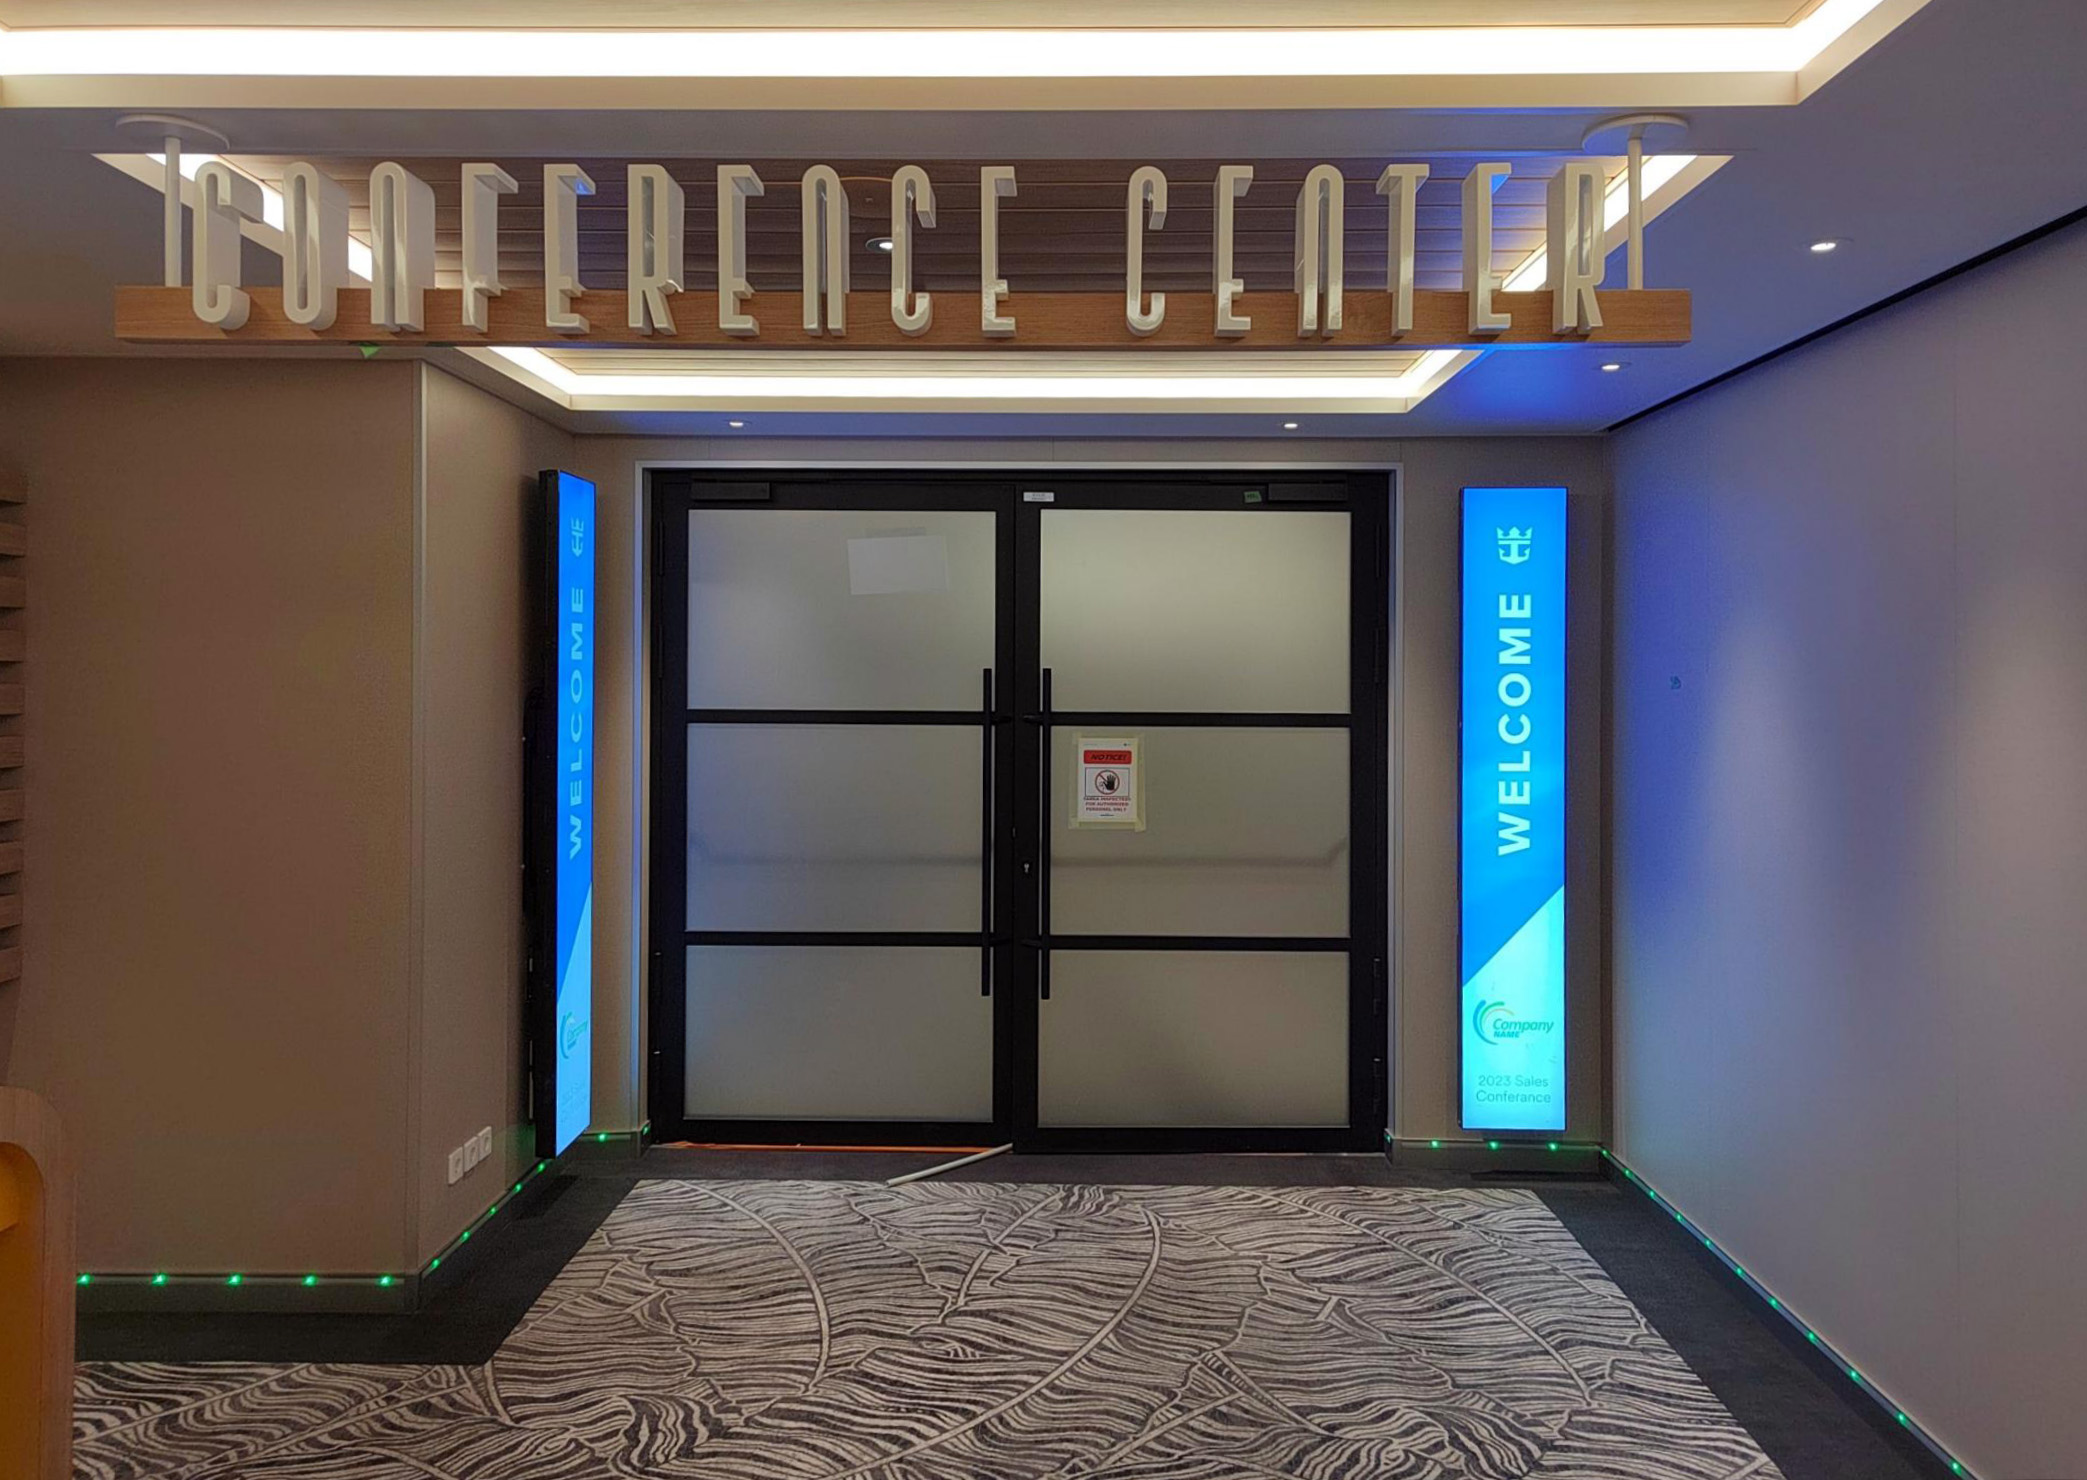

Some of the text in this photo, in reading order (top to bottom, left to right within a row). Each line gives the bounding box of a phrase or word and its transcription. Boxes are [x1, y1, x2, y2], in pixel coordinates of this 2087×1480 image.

[193, 161, 1605, 336] CONFERENCE CENTER
[570, 587, 583, 860] WELCOME
[1498, 594, 1532, 856] WELCOME
[1478, 1075, 1549, 1087] 2023 Sales
[1493, 1018, 1554, 1034] Company
